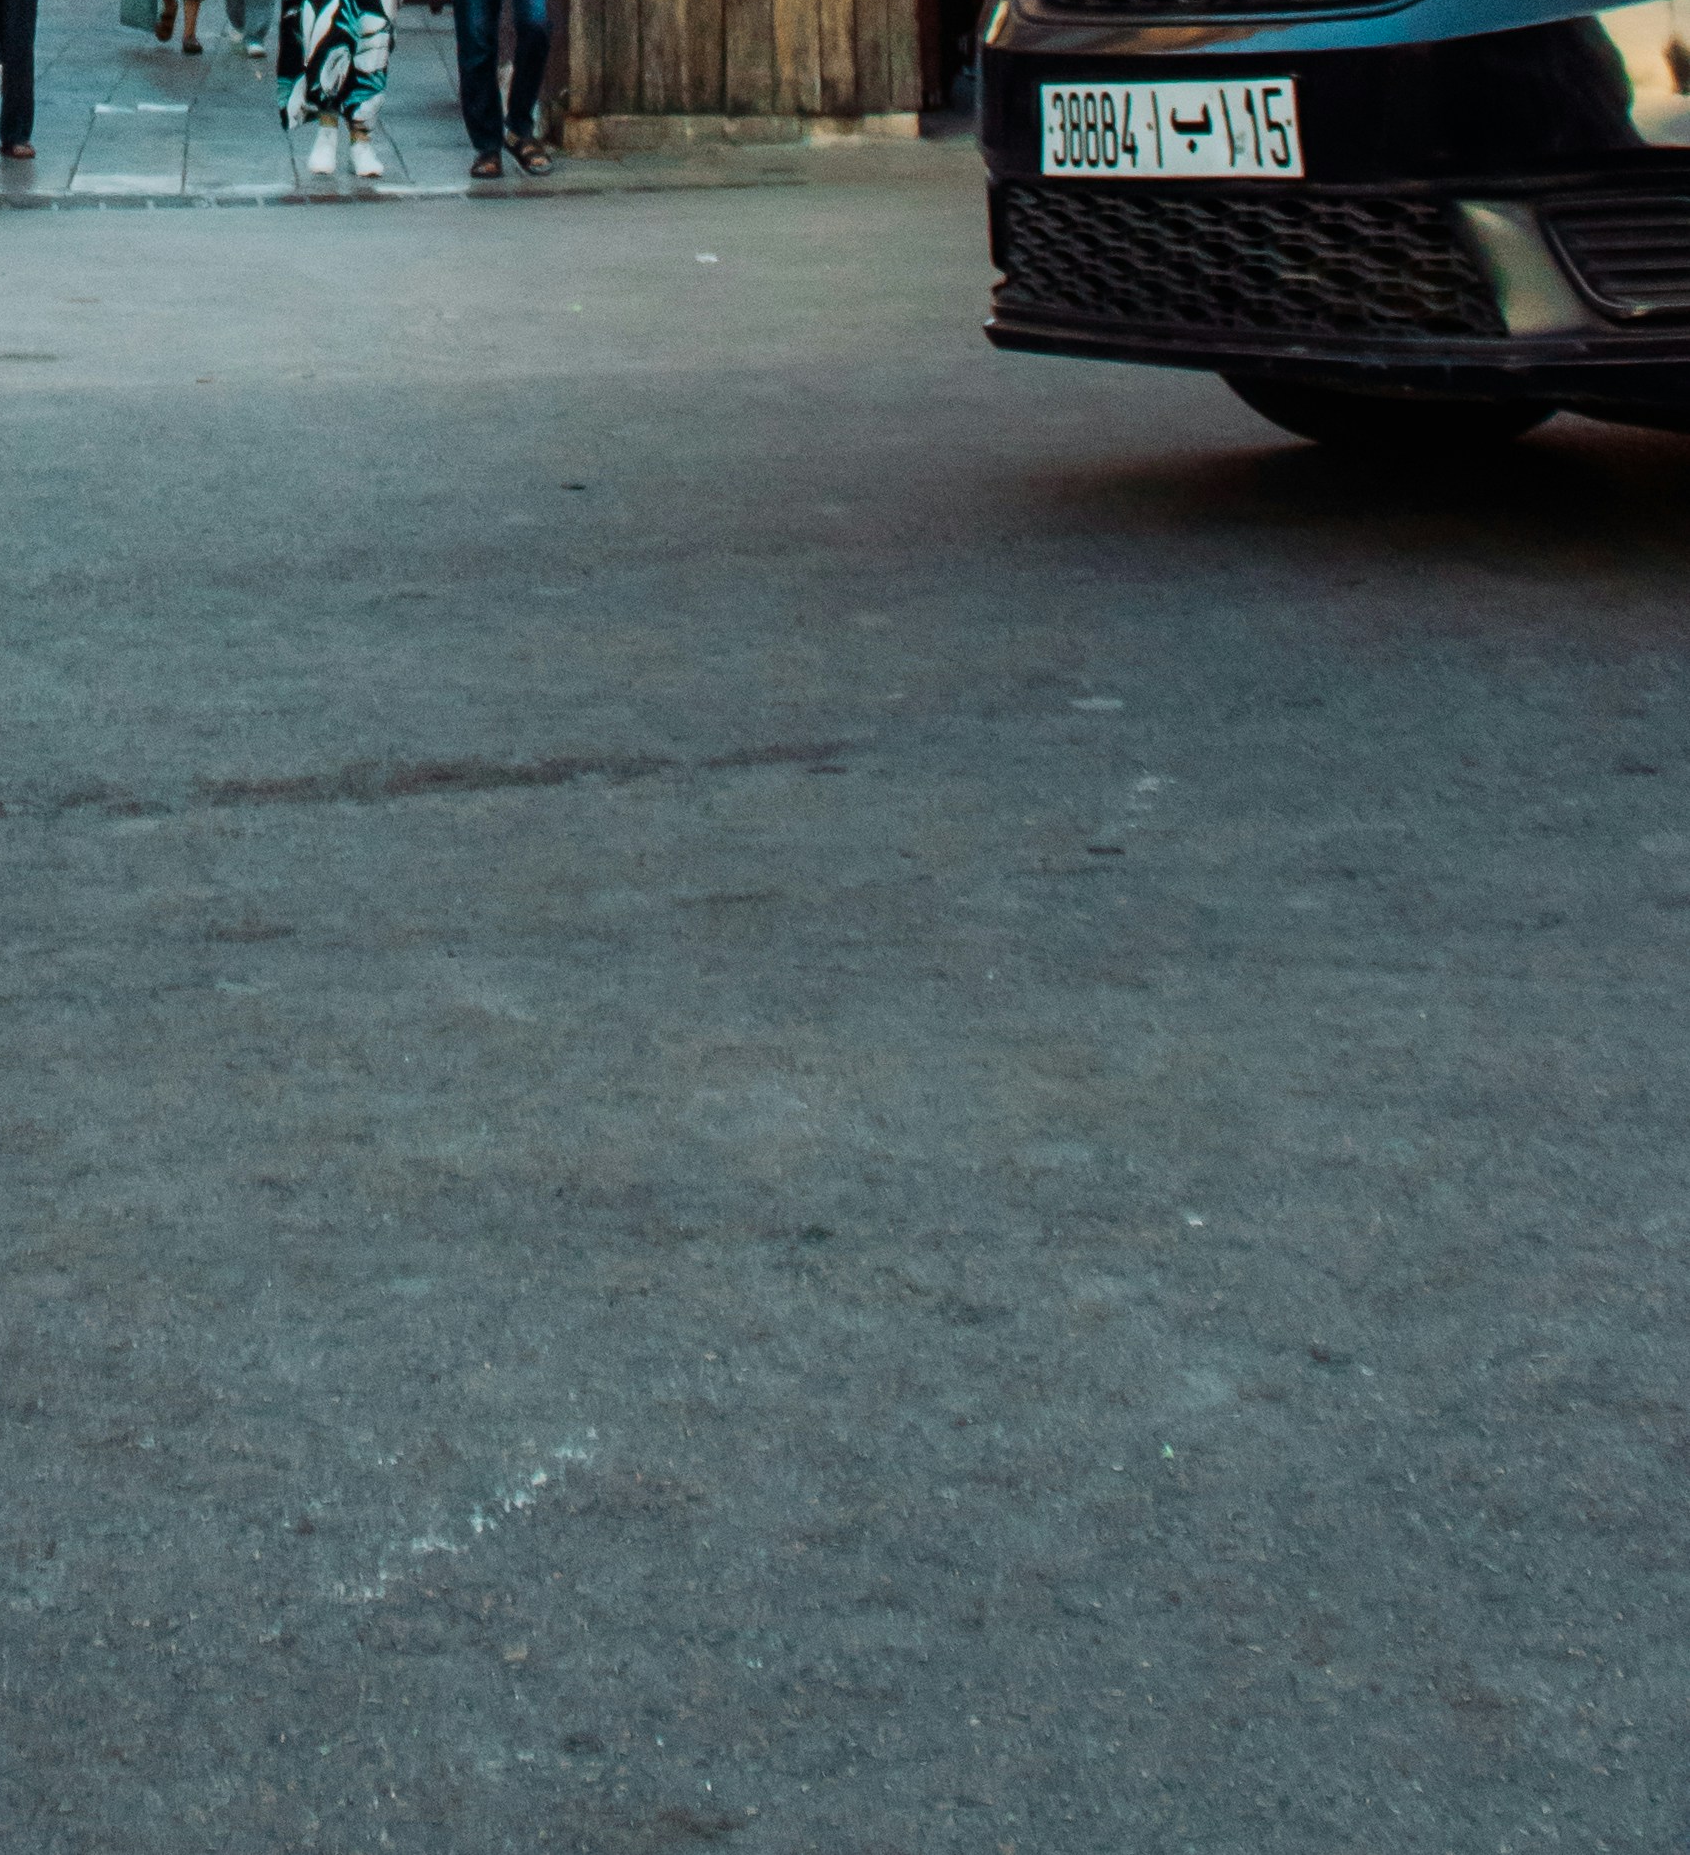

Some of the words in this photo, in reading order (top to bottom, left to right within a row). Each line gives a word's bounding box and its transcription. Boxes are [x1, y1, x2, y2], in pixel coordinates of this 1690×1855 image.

[1052, 91, 1138, 168] 38884
[1169, 101, 1213, 154] ب
[1243, 86, 1291, 168] 15
